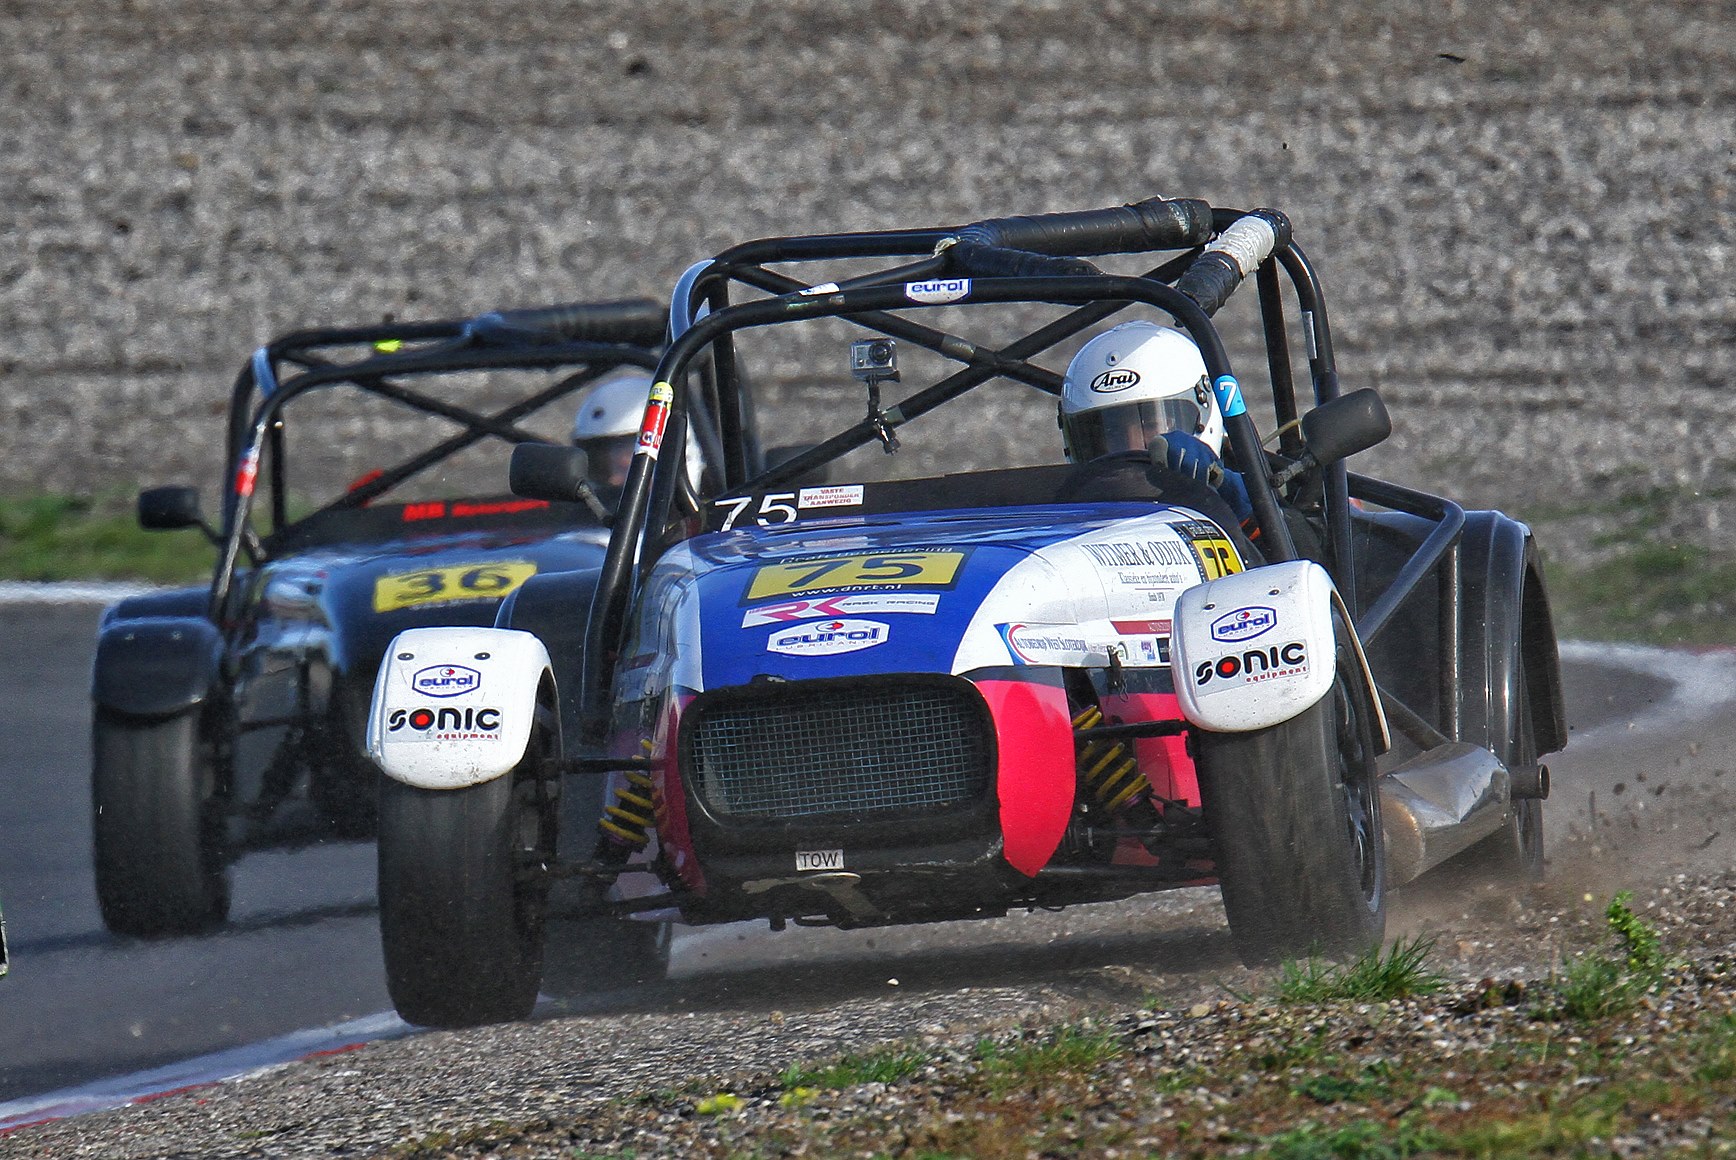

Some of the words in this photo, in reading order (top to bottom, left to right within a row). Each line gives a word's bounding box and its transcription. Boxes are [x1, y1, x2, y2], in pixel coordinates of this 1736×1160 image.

[912, 281, 962, 292] eurol
[1094, 372, 1133, 389] Arai
[1219, 381, 1237, 411] 7
[715, 493, 798, 532] 75
[785, 556, 927, 588] 75
[396, 566, 511, 601] 36
[1218, 613, 1270, 634] eurol
[777, 627, 880, 647] eurol
[419, 675, 473, 687] eurol
[1246, 666, 1307, 682] equipment
[437, 732, 499, 740] equipment
[800, 852, 839, 868] TOW
